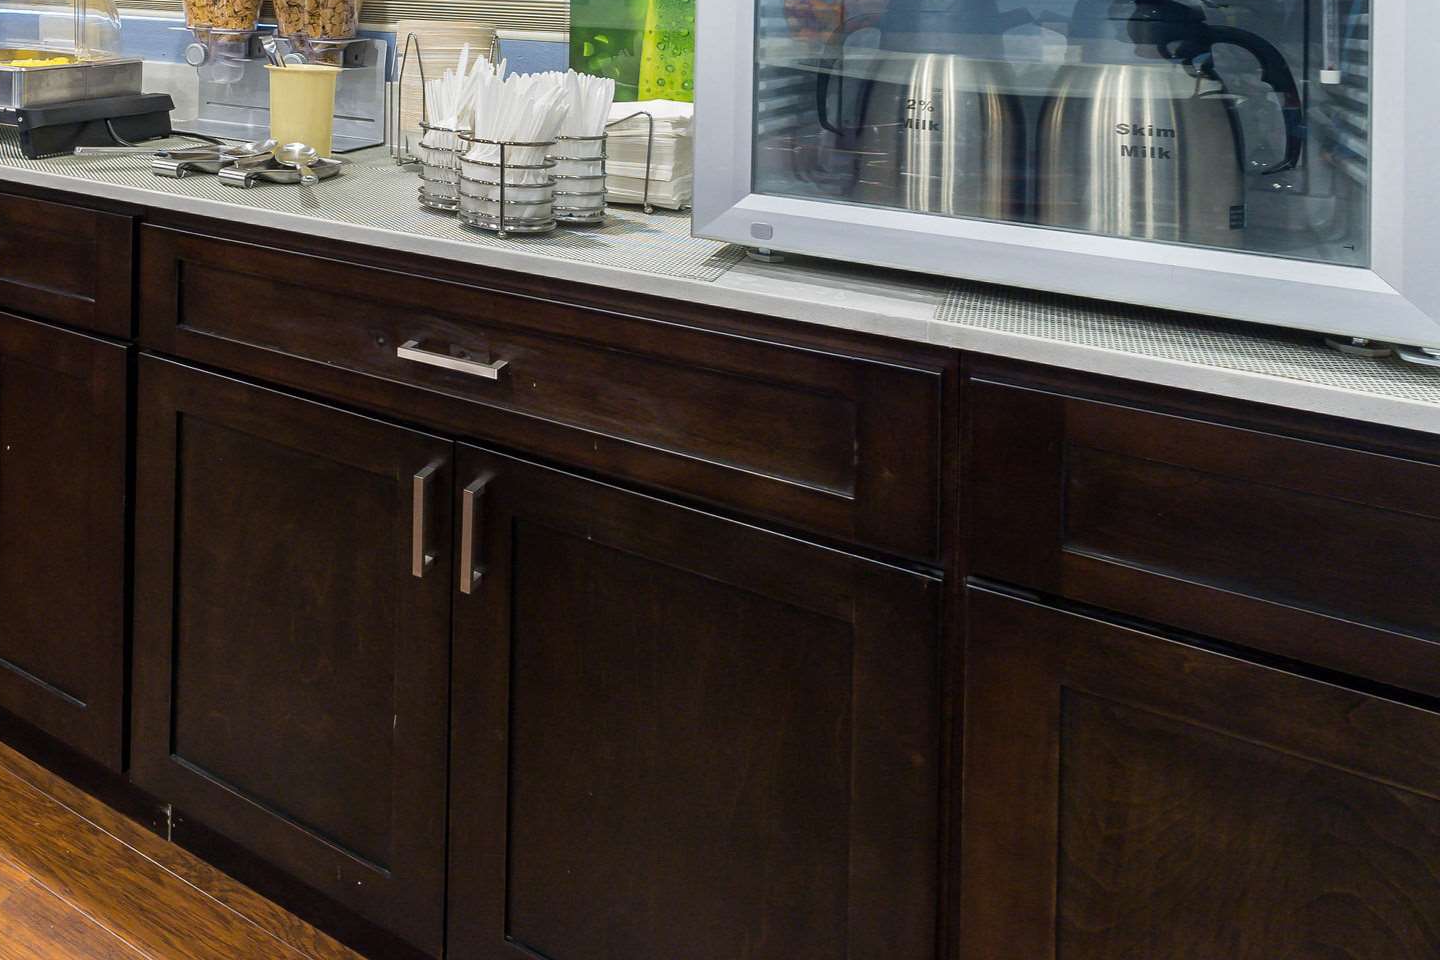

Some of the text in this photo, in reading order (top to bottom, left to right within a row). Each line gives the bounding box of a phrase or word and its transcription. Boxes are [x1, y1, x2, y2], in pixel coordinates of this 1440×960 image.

[905, 98, 935, 113] 2%
[1115, 123, 1176, 138] Skim
[1120, 144, 1171, 160] Milk
